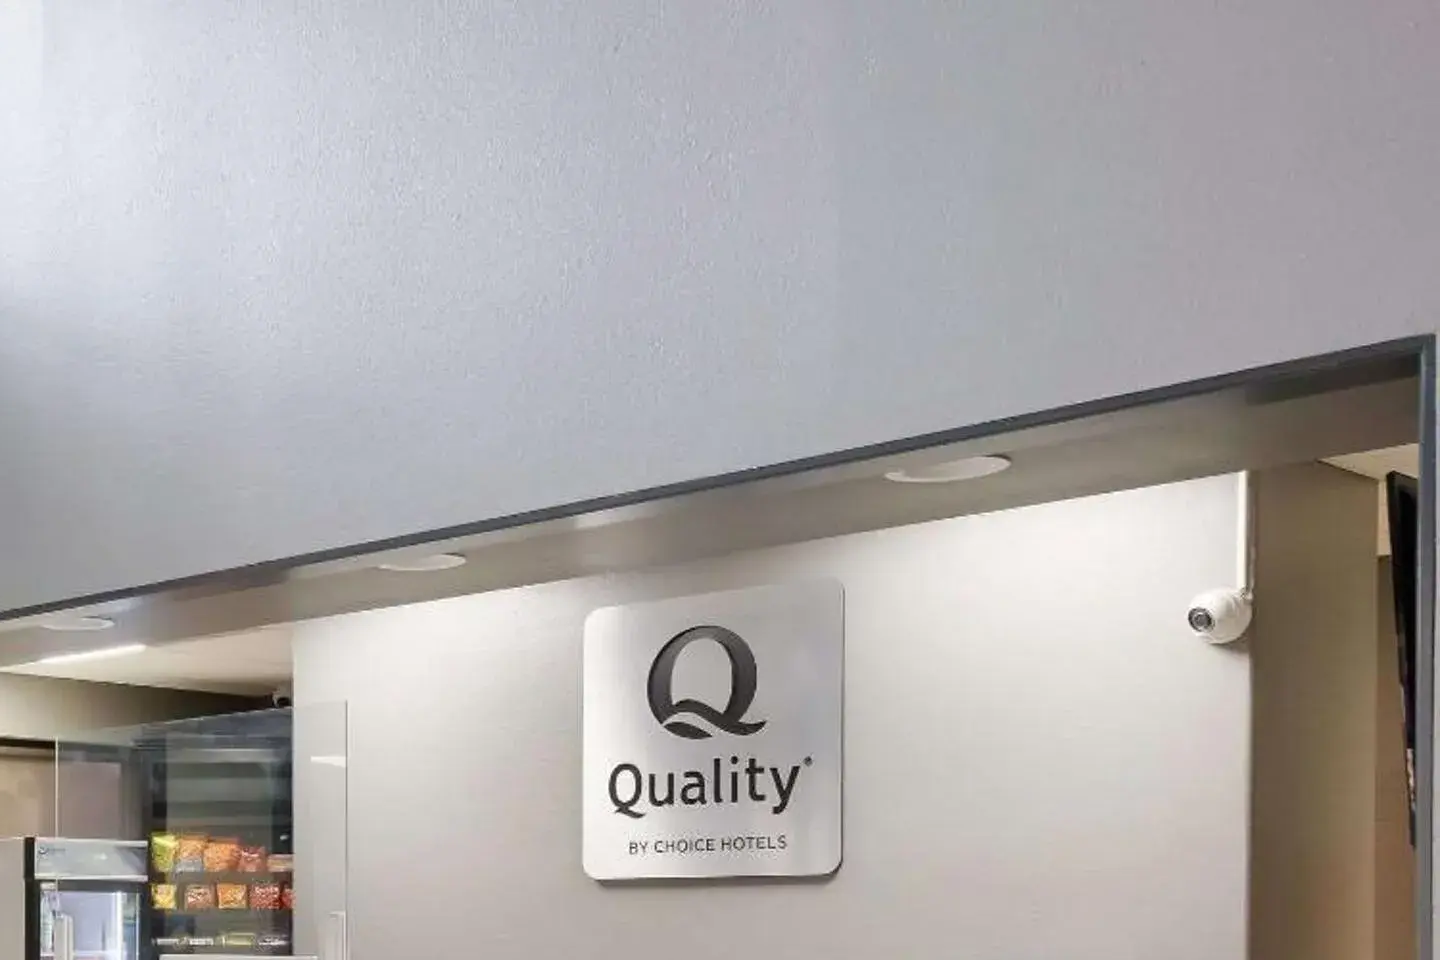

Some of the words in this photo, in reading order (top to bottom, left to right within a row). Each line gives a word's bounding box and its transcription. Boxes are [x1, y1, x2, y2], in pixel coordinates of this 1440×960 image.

[646, 625, 767, 740] Q
[608, 755, 801, 819] Quality
[628, 842, 649, 855] BY
[654, 838, 717, 854] CHOICE
[721, 834, 789, 852] HOTELS
